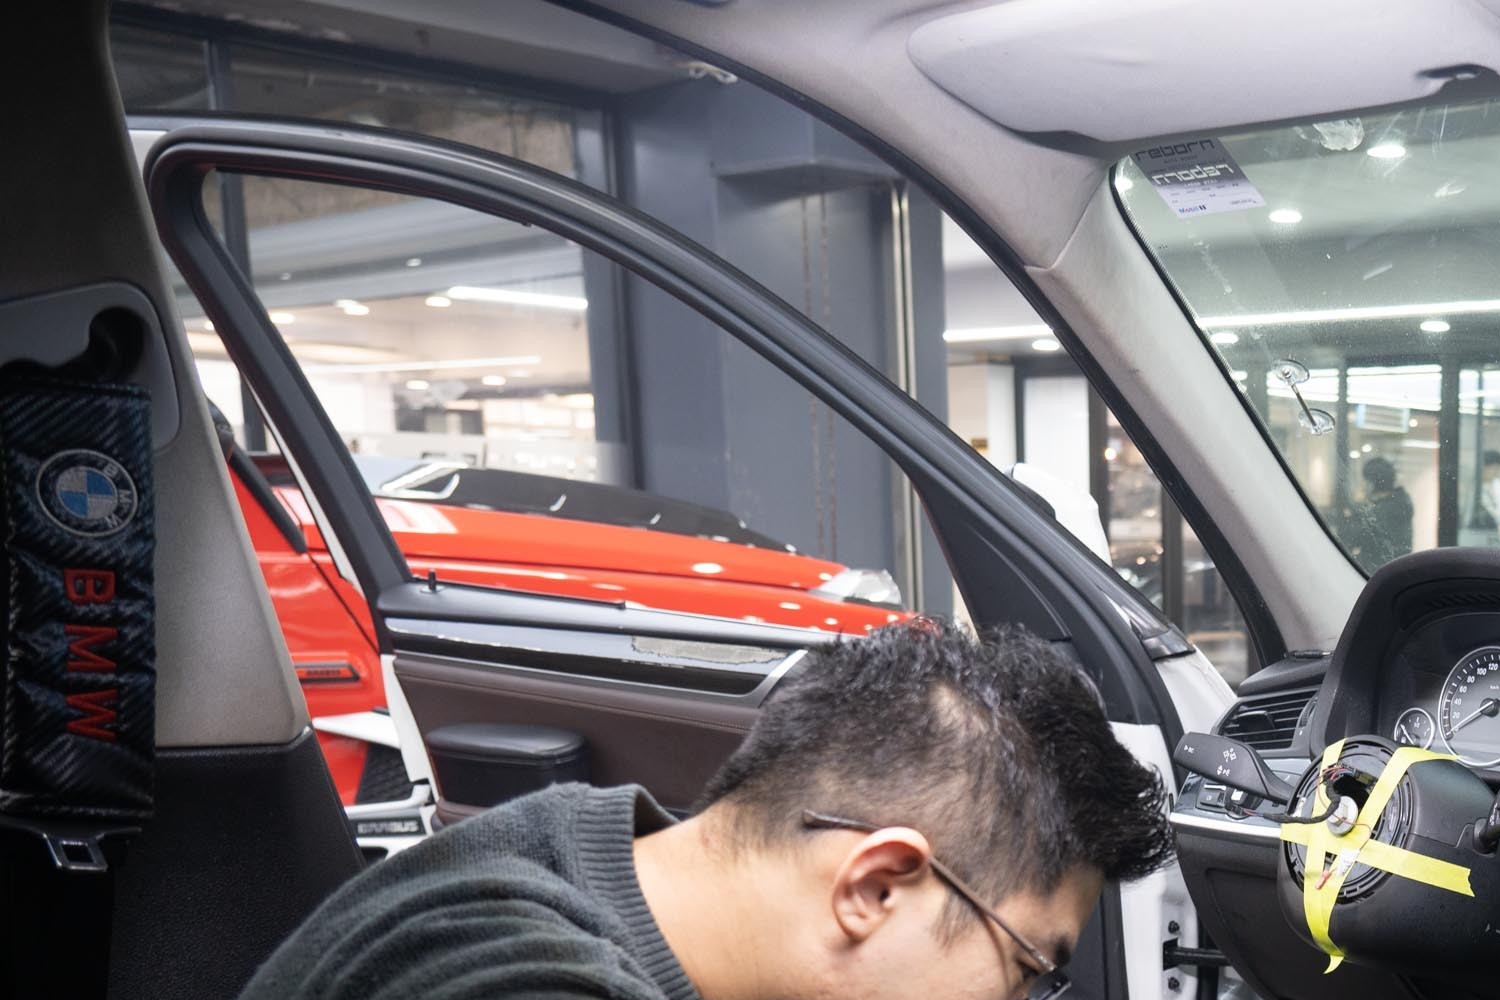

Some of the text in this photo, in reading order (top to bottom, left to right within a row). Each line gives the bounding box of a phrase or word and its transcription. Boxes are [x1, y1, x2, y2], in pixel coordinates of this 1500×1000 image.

[1135, 139, 1215, 161] reborn
[64, 568, 118, 742] BMW
[1488, 663, 1499, 671] 120
[1476, 668, 1487, 676] 100
[1459, 685, 1467, 693] 60
[1454, 698, 1462, 706] 40
[1452, 711, 1460, 719] 20
